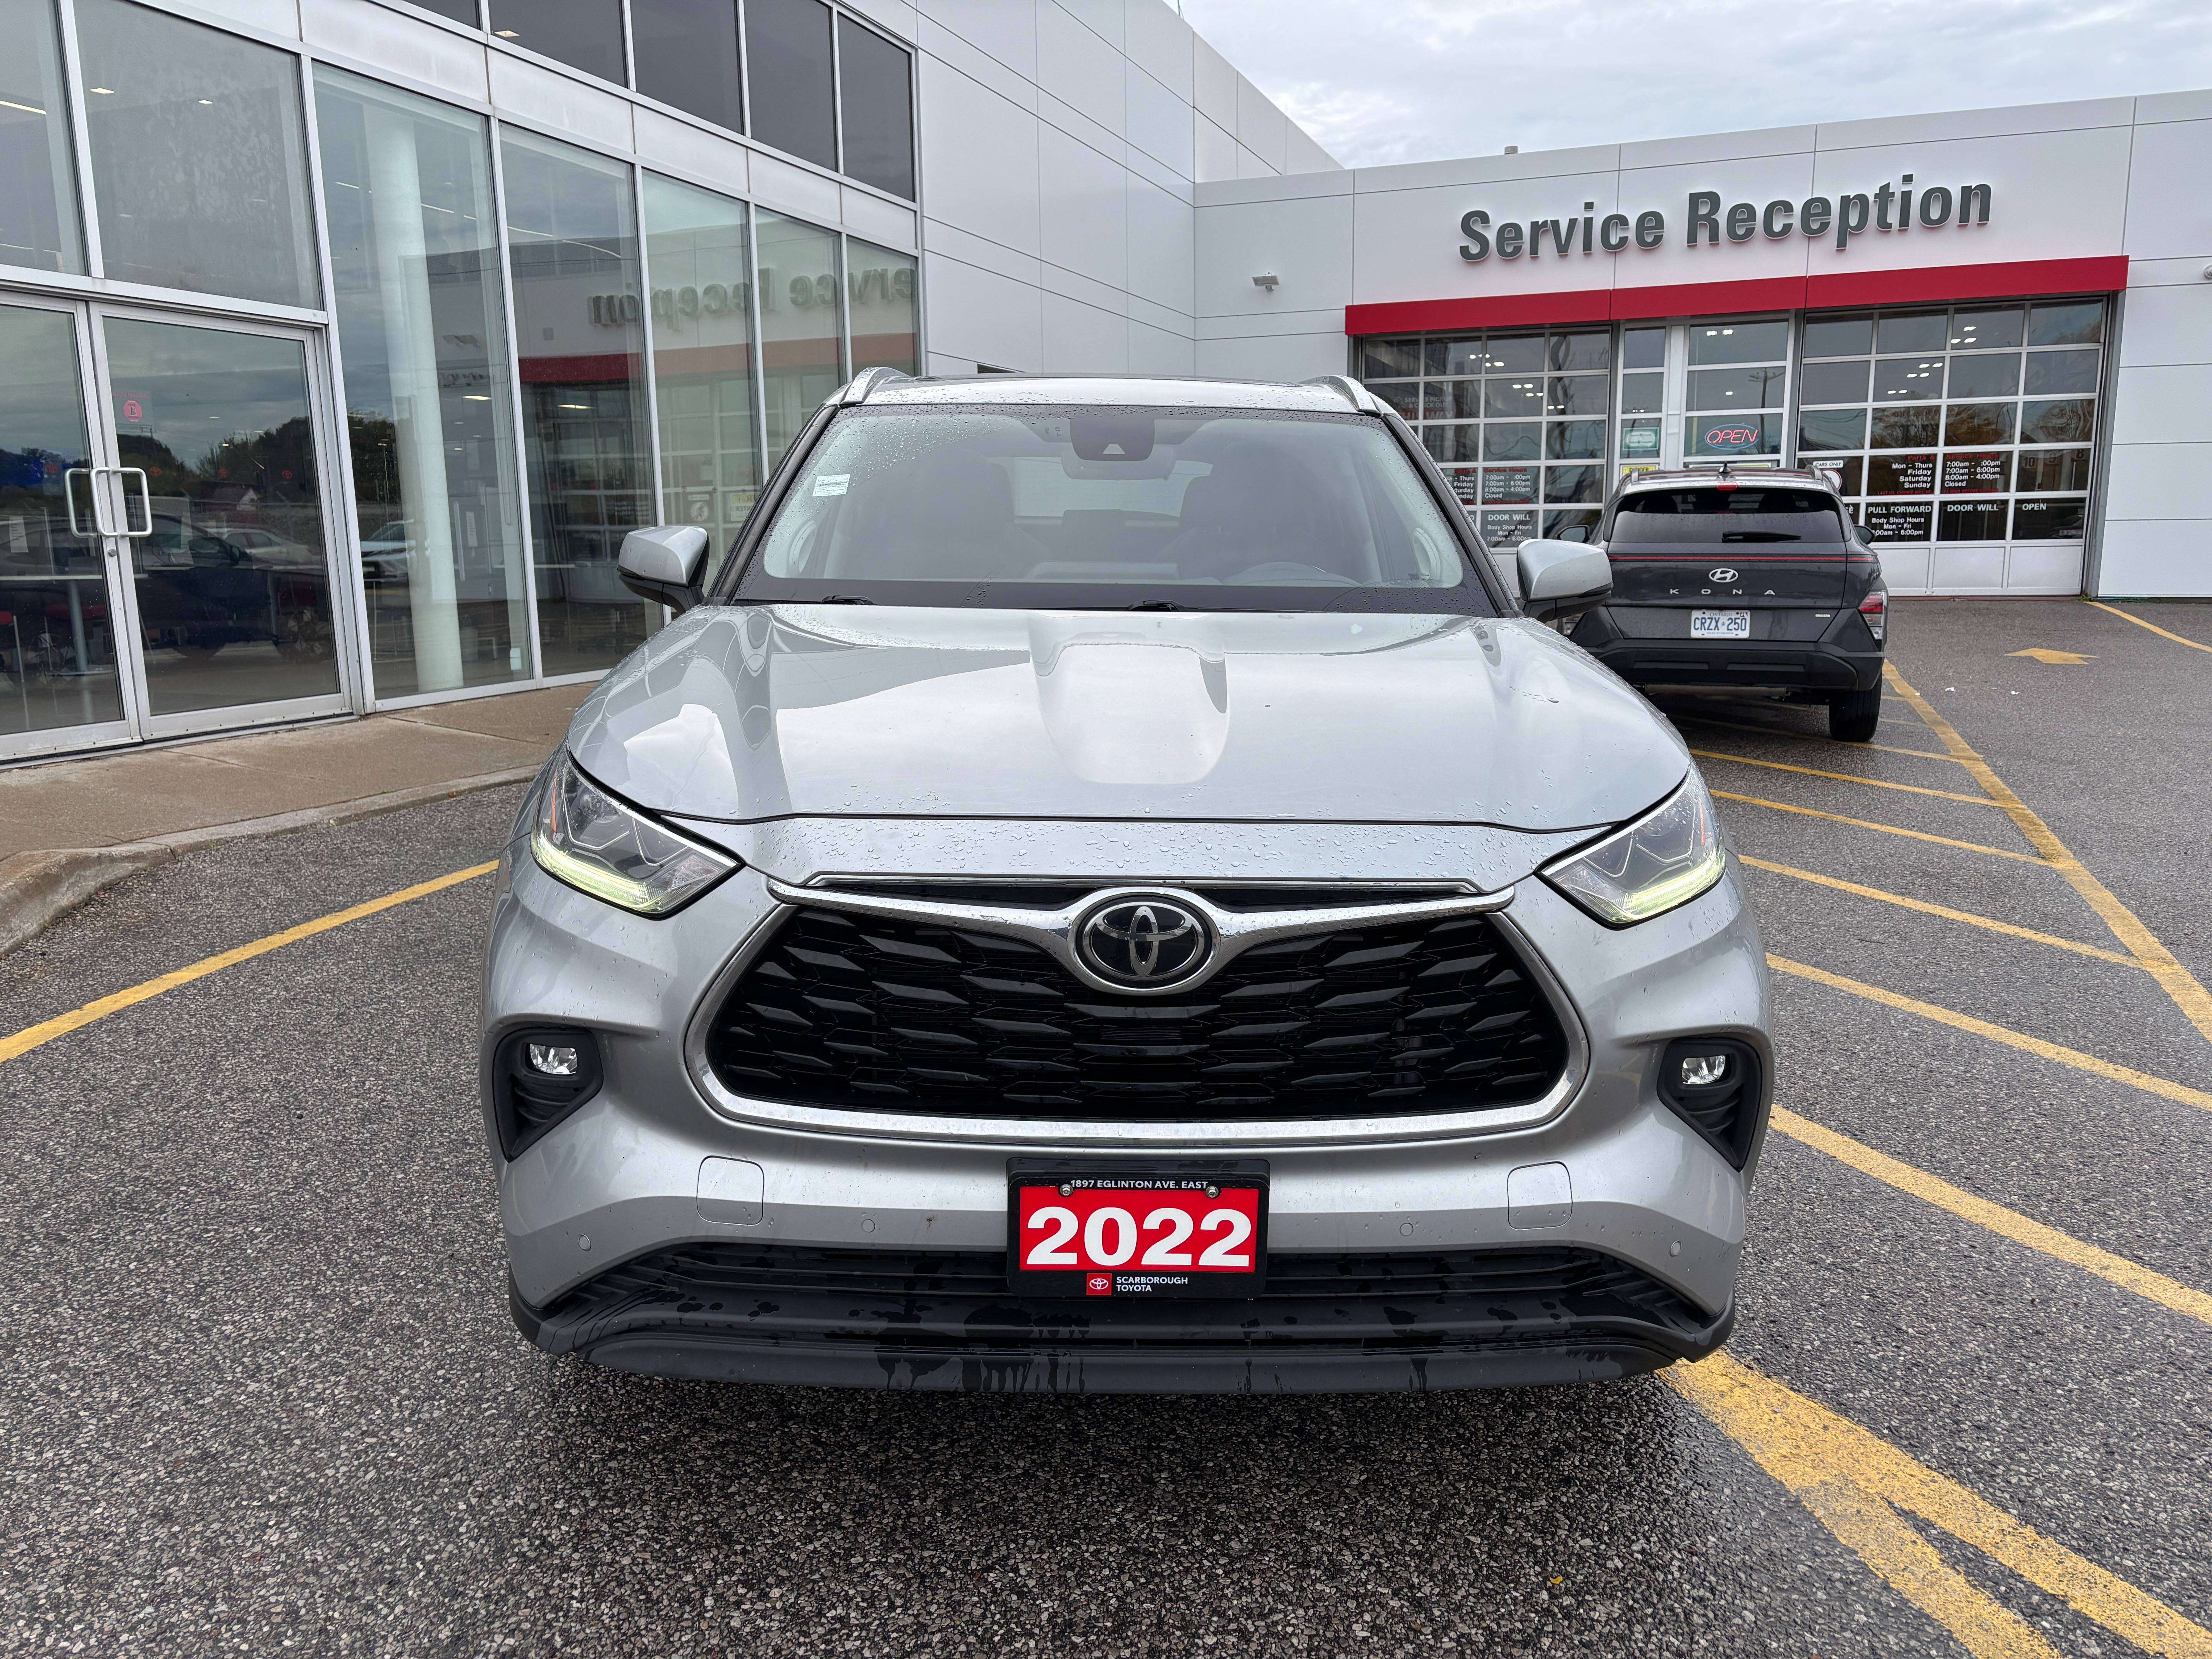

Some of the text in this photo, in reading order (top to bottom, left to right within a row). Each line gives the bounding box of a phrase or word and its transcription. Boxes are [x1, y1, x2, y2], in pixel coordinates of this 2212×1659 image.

[1459, 173, 1992, 262] Service Reception
[1707, 429, 1758, 444] OPEN
[1693, 617, 1747, 631] CRZX 250
[1097, 1180, 1152, 1188] EGLINTON
[1027, 1206, 1251, 1267] 2022
